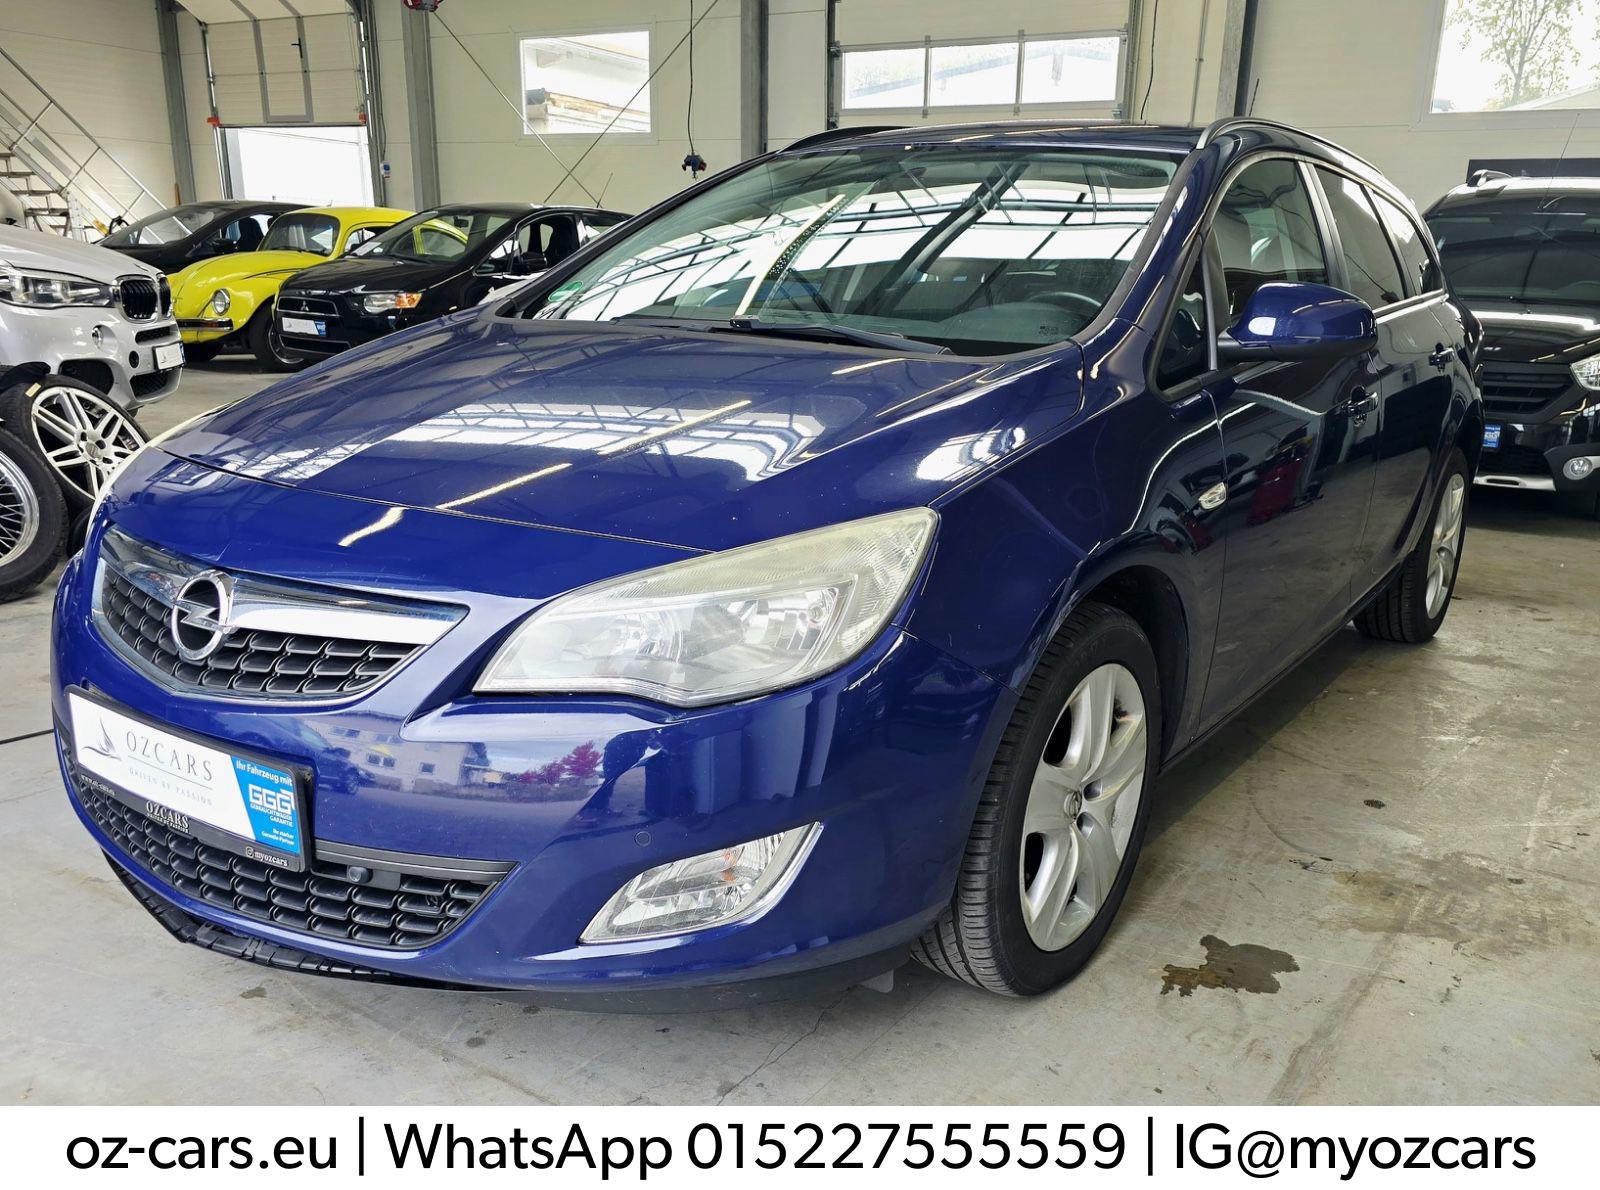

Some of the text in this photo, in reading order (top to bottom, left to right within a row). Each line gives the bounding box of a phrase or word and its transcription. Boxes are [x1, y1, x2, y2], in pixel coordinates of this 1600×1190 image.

[126, 731, 213, 782] OZCARS
[236, 760, 293, 787] Ihr Fahrzeug mit
[249, 784, 294, 815] GGG
[146, 800, 189, 829] OZCARS
[254, 849, 288, 867] myozcars
